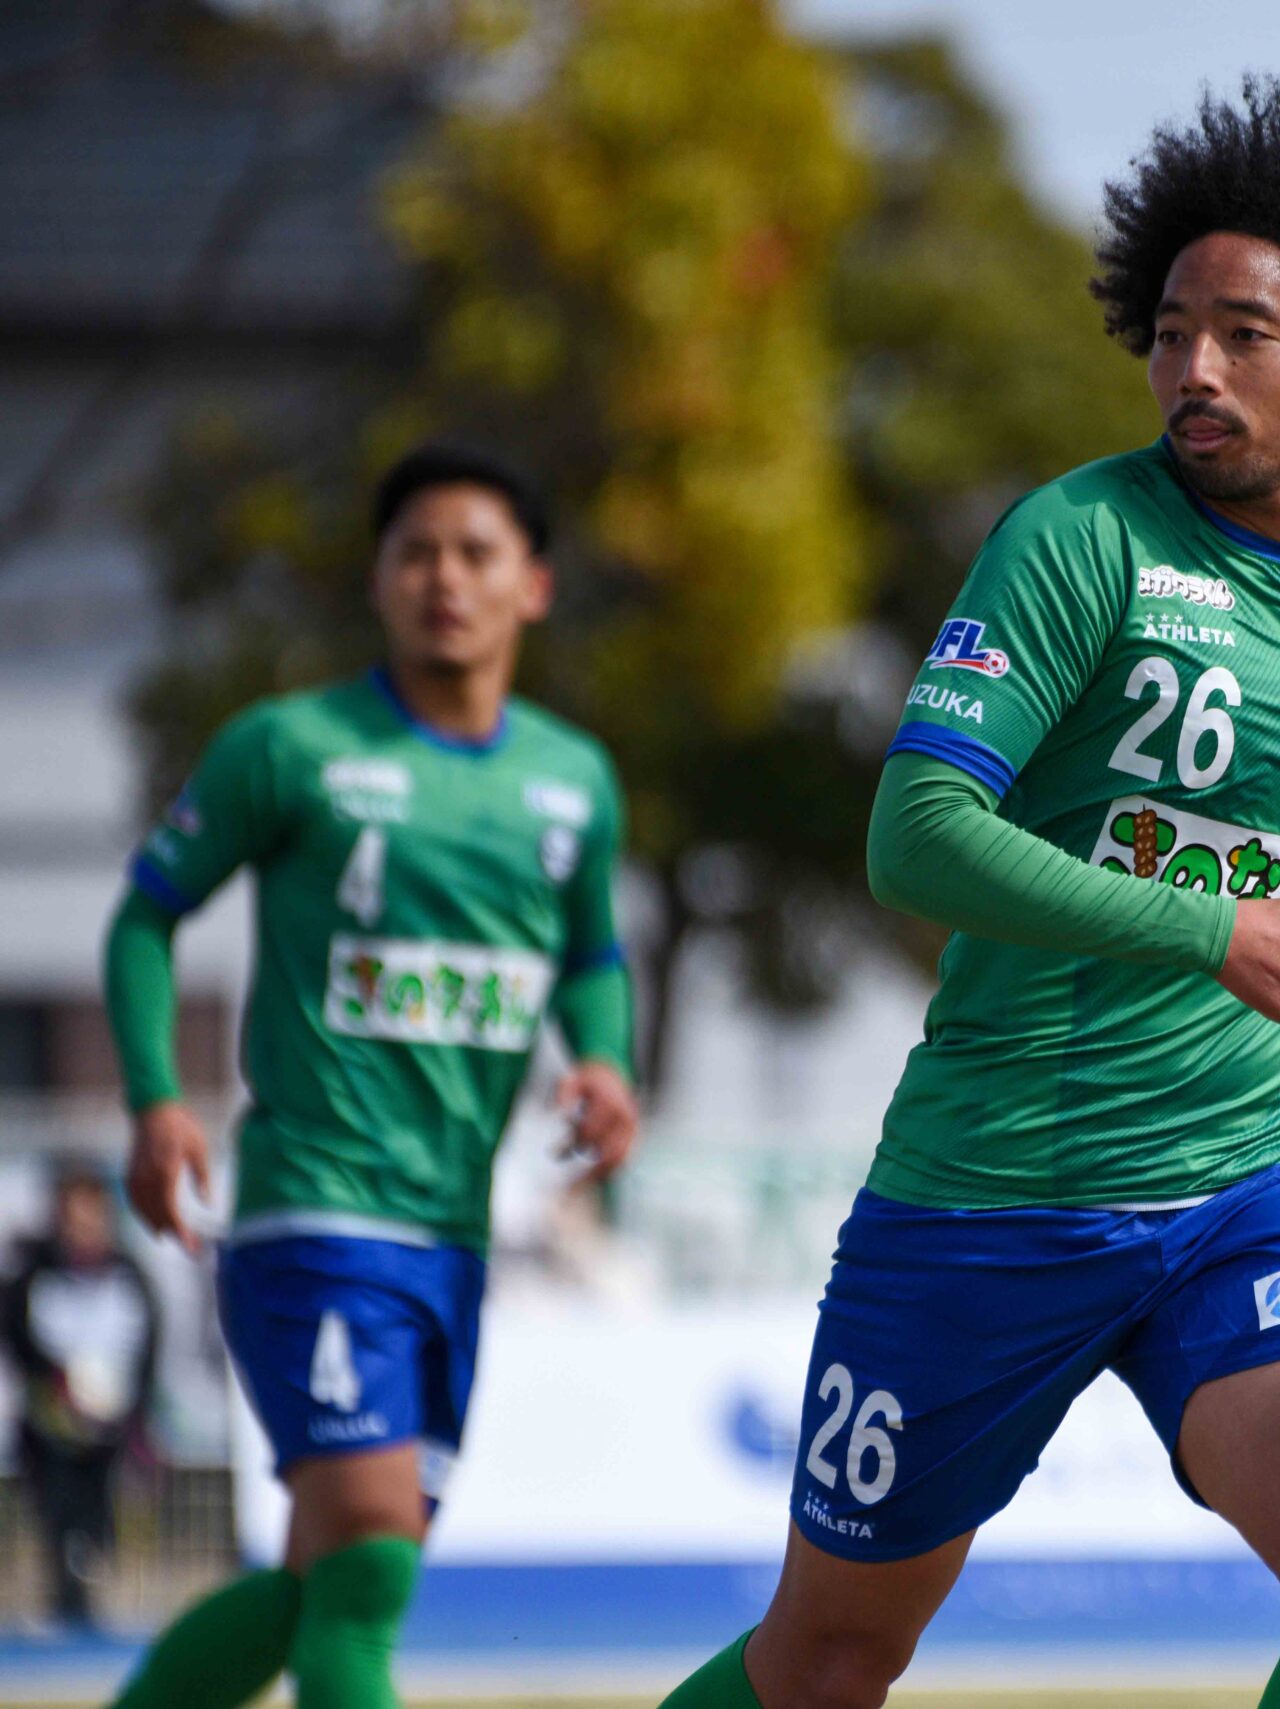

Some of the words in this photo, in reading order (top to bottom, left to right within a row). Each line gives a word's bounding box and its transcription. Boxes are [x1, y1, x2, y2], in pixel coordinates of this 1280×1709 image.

[1143, 623, 1236, 648] ATHLETA
[1107, 656, 1242, 790] 26
[310, 1309, 362, 1413] 4
[806, 1362, 903, 1505] 26
[802, 1500, 873, 1539] ATHLETA
